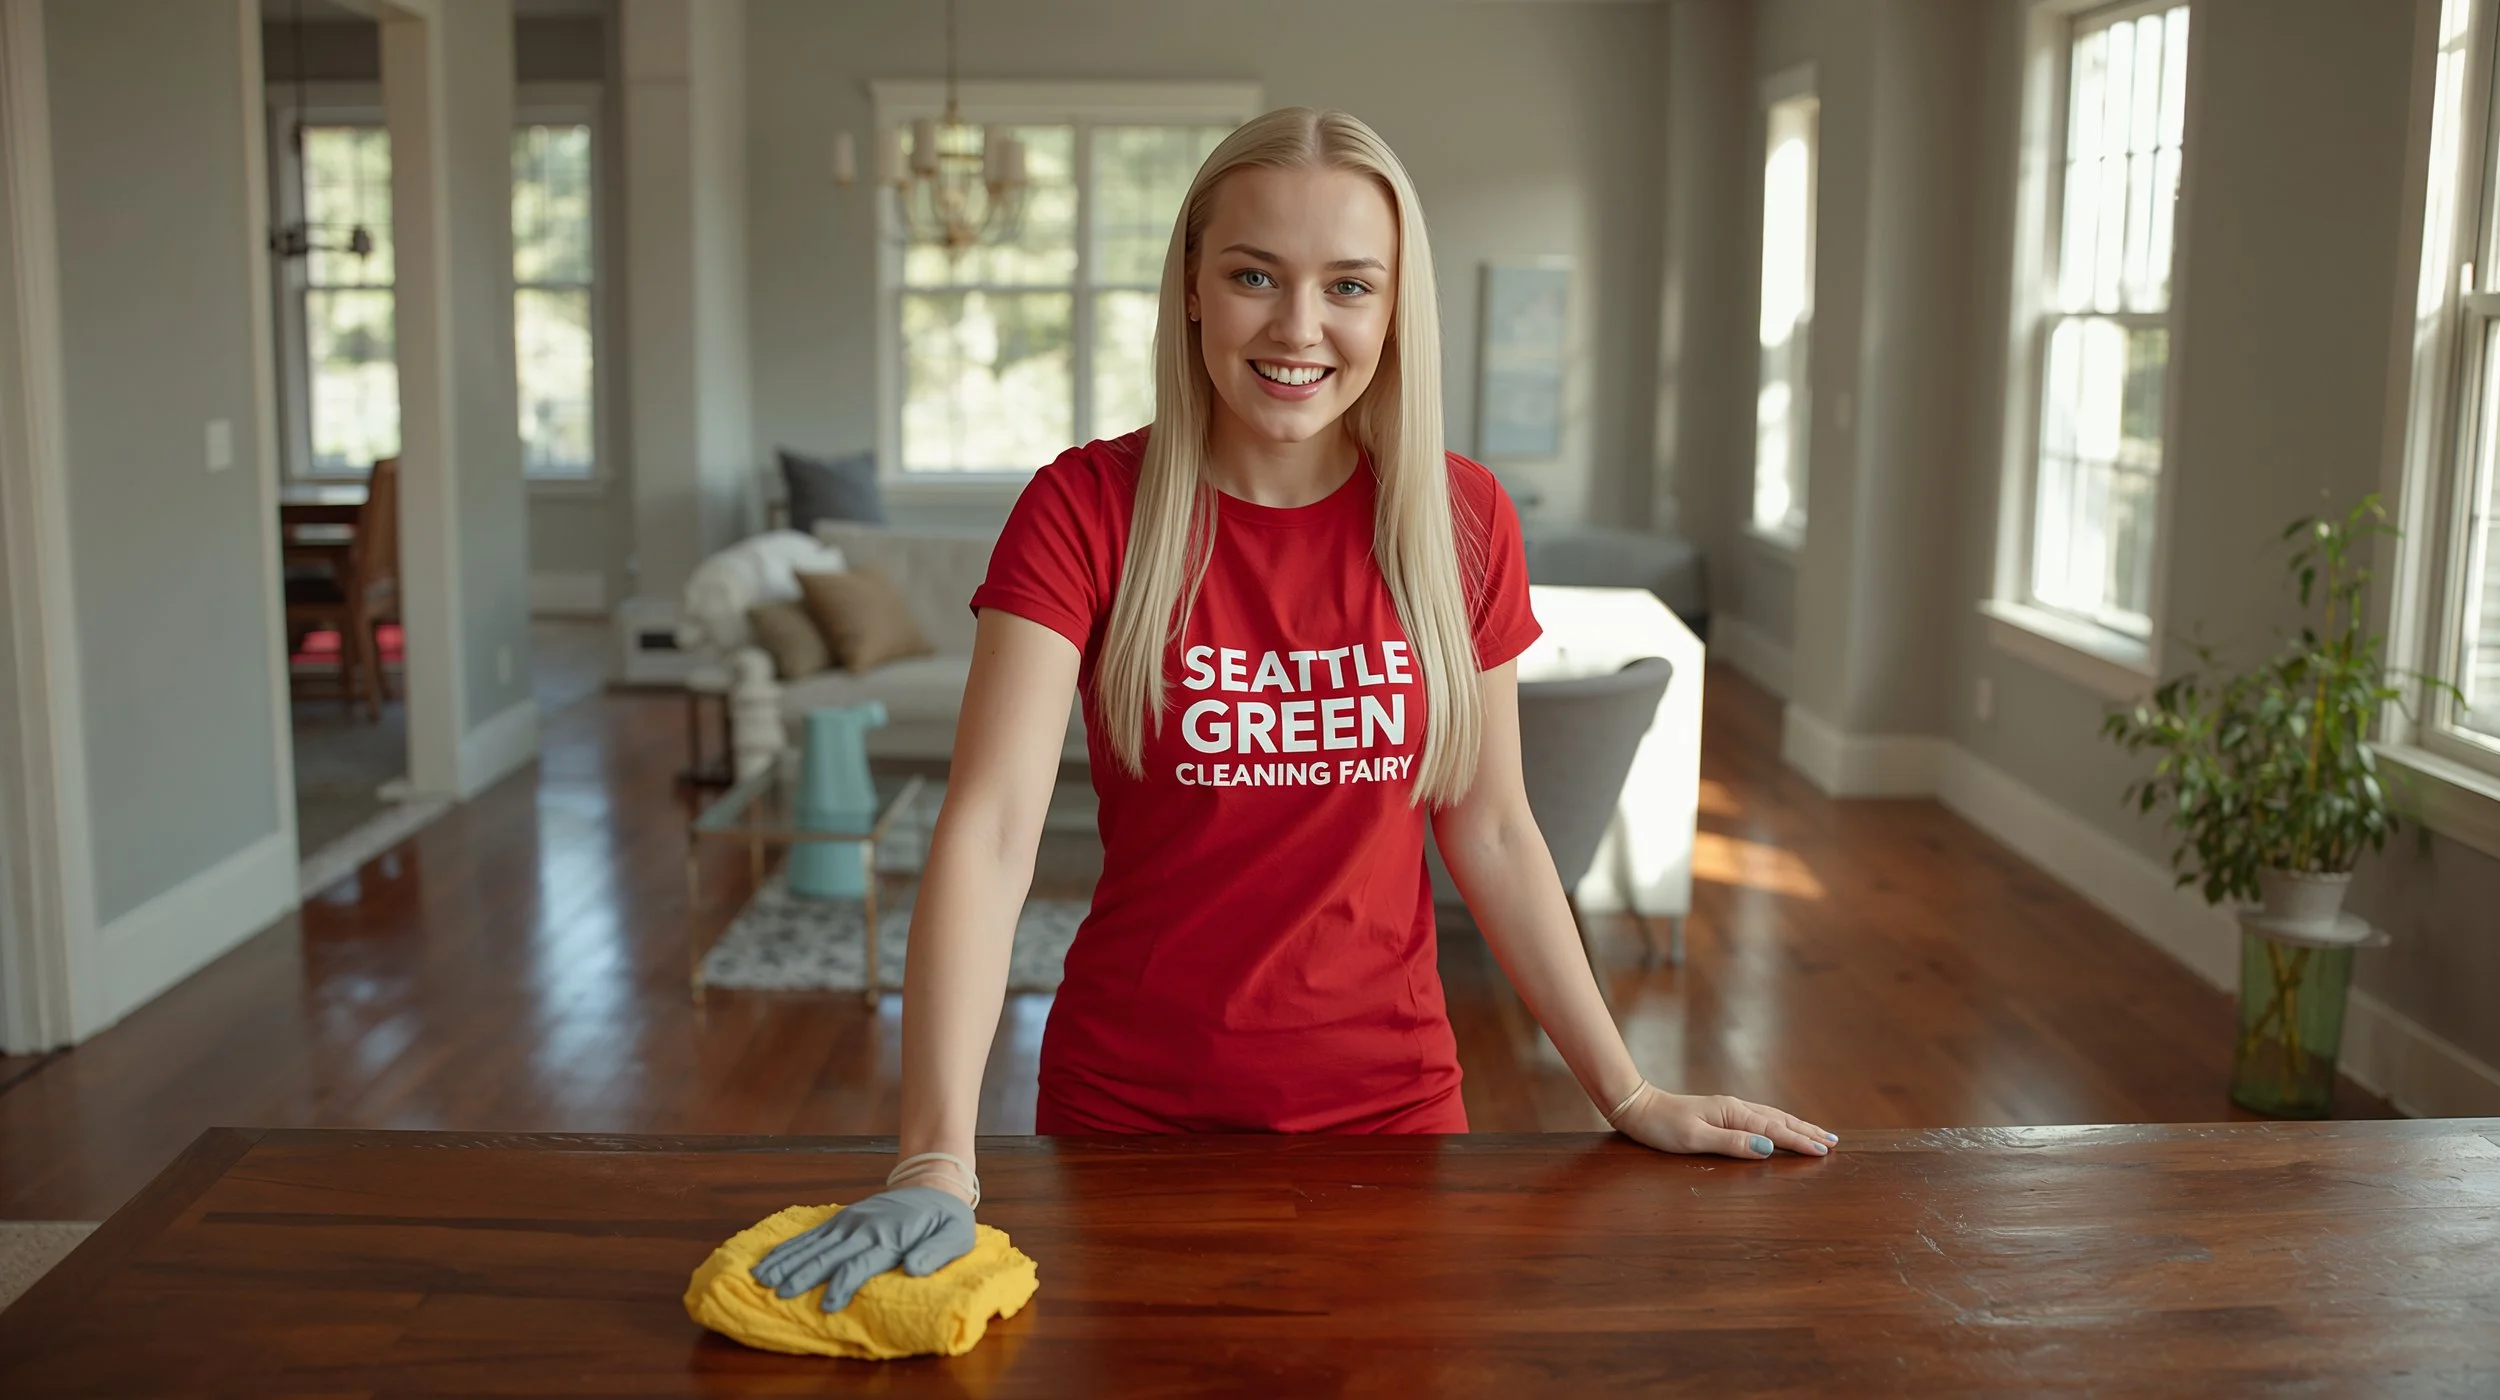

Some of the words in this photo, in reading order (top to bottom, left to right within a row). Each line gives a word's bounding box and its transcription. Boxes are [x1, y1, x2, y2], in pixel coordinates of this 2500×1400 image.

[1182, 640, 1413, 692] SEATTLE
[1181, 693, 1405, 754] GREEN
[1175, 762, 1331, 787] CLEANING
[1339, 754, 1414, 785] FAIRY
